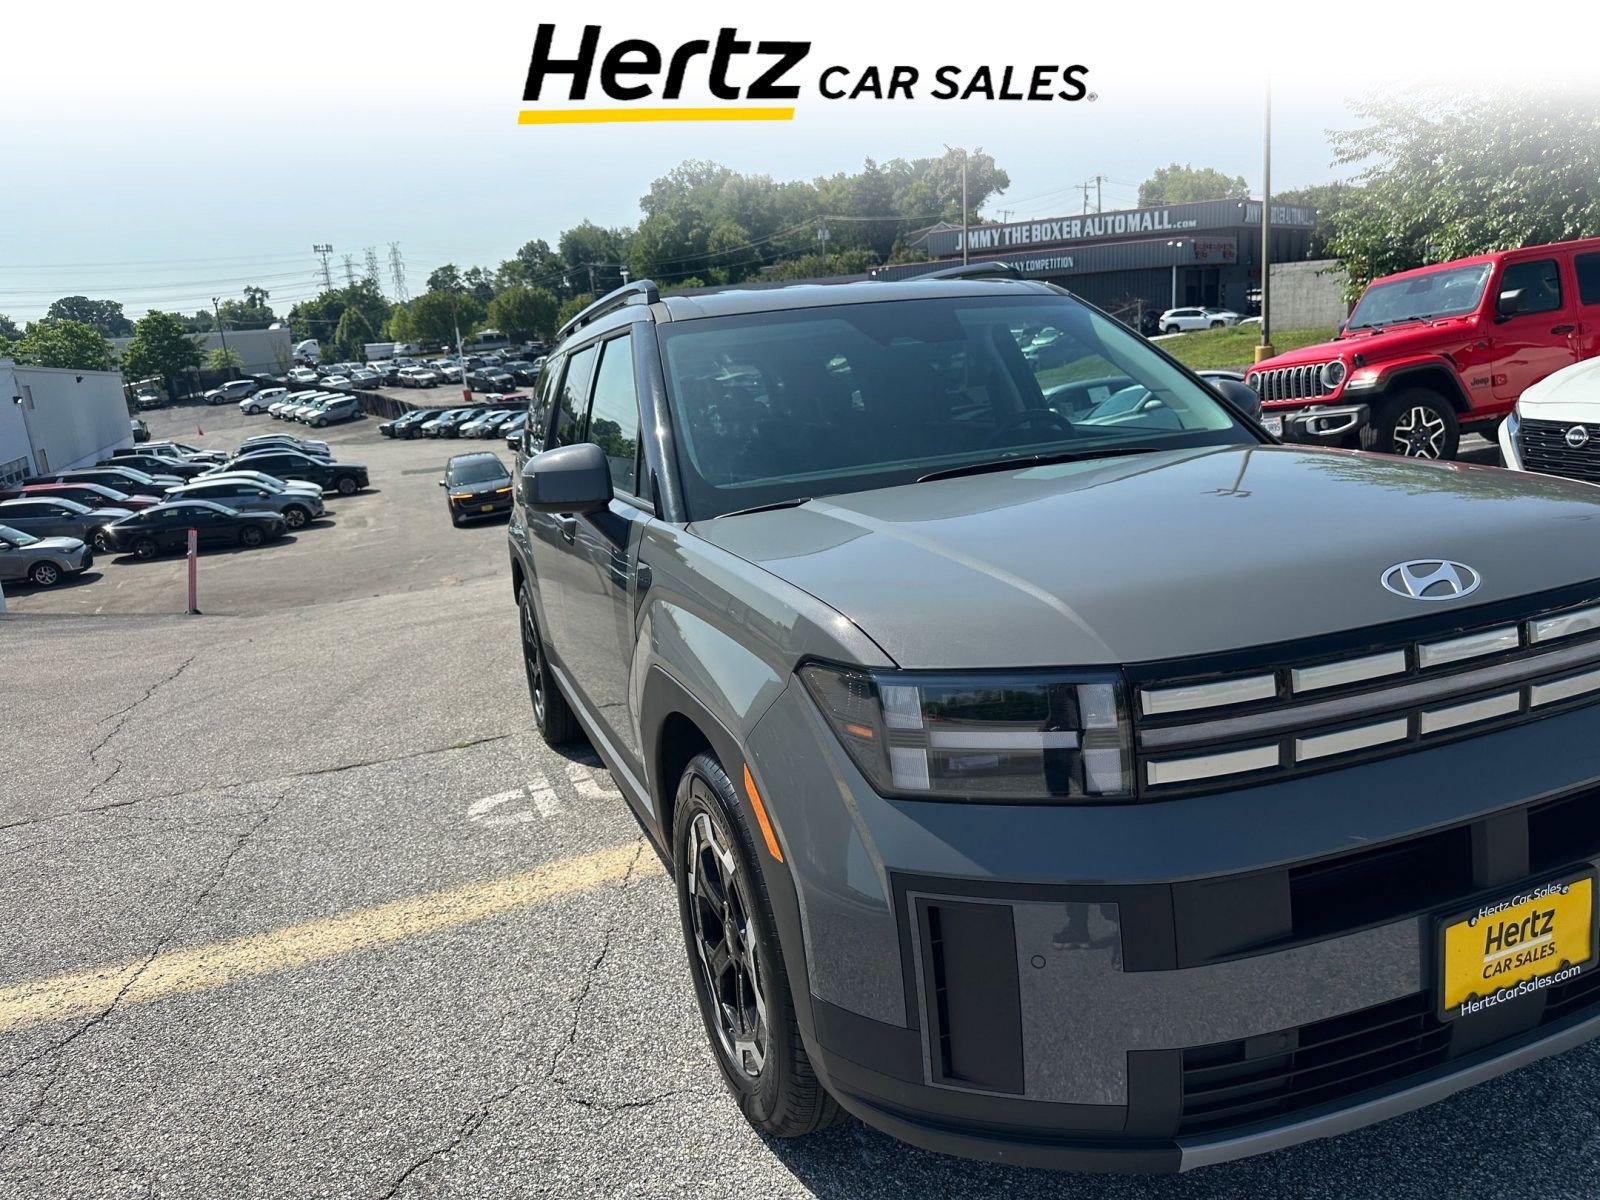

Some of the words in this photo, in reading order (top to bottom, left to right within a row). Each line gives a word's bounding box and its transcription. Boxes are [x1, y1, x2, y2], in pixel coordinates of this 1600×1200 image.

[955, 228, 1001, 251] JMMY
[1003, 226, 1030, 246] THE
[1031, 219, 1081, 243] BOXER
[1026, 256, 1074, 272] COMPETITION
[1471, 376, 1490, 386] Jeep
[1478, 901, 1509, 919] Hertz
[1511, 894, 1531, 908] Car
[1534, 883, 1561, 898] Sales
[1484, 909, 1556, 955] Hertz
[1482, 957, 1511, 979] CAR
[1461, 965, 1581, 1016] HertzCarSales.com
